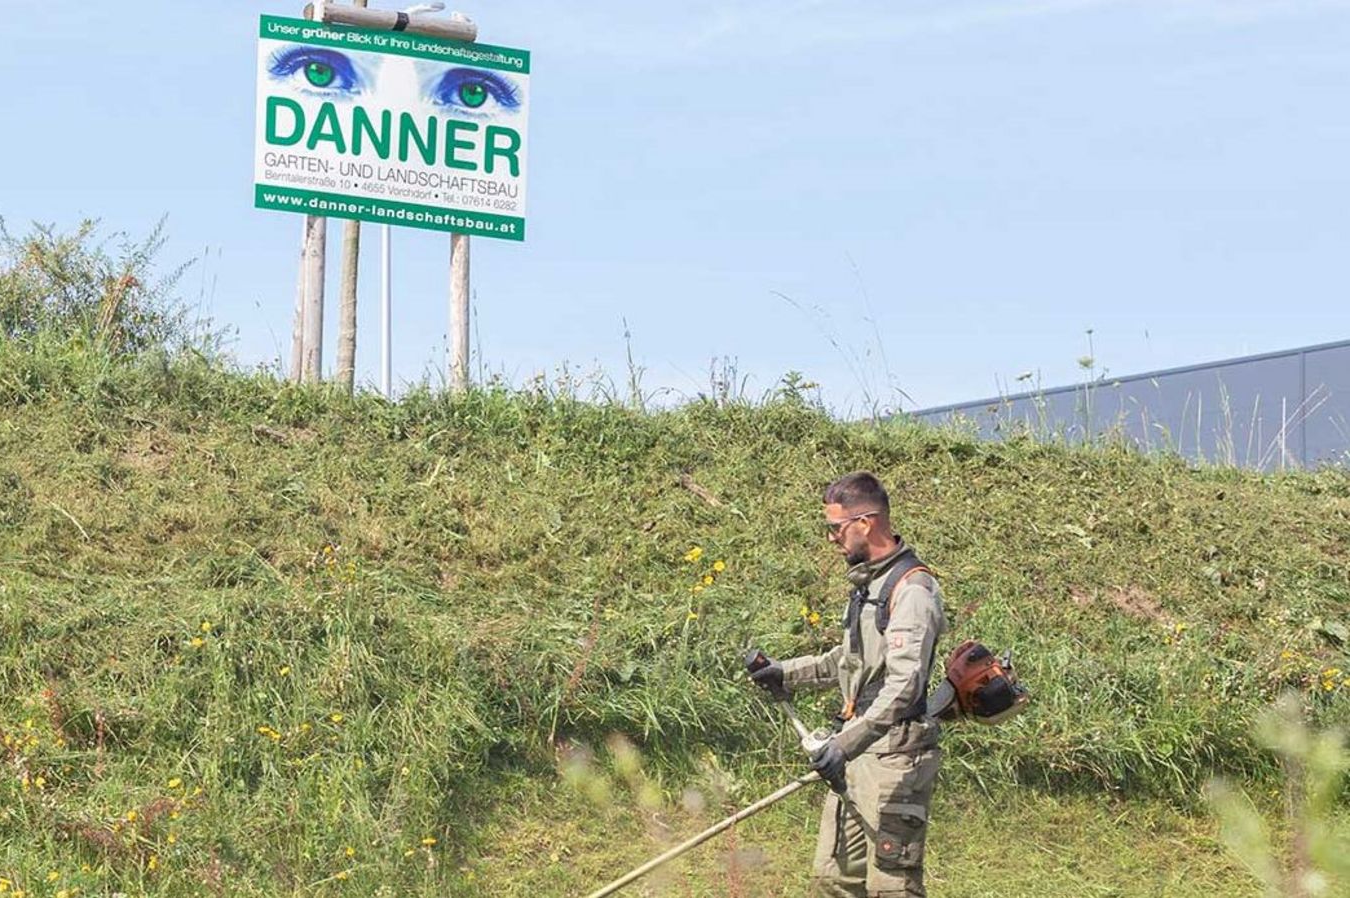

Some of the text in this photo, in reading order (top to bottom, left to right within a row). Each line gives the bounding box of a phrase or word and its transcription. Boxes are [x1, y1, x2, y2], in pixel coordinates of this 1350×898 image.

[267, 22, 300, 35] Unser
[302, 28, 346, 40] grüner
[347, 32, 372, 44] Blick
[373, 35, 389, 46] für
[390, 38, 410, 49] Ihre
[265, 96, 522, 178] DANNER
[264, 152, 519, 199] GARTEN- UND LANDSCHAFTSBAU
[340, 179, 351, 190] 10
[361, 181, 386, 194] 4655
[388, 185, 432, 200] Vorchdorf
[461, 195, 491, 207] 07614
[263, 192, 517, 234] www.danner-landschaftsbau.at
